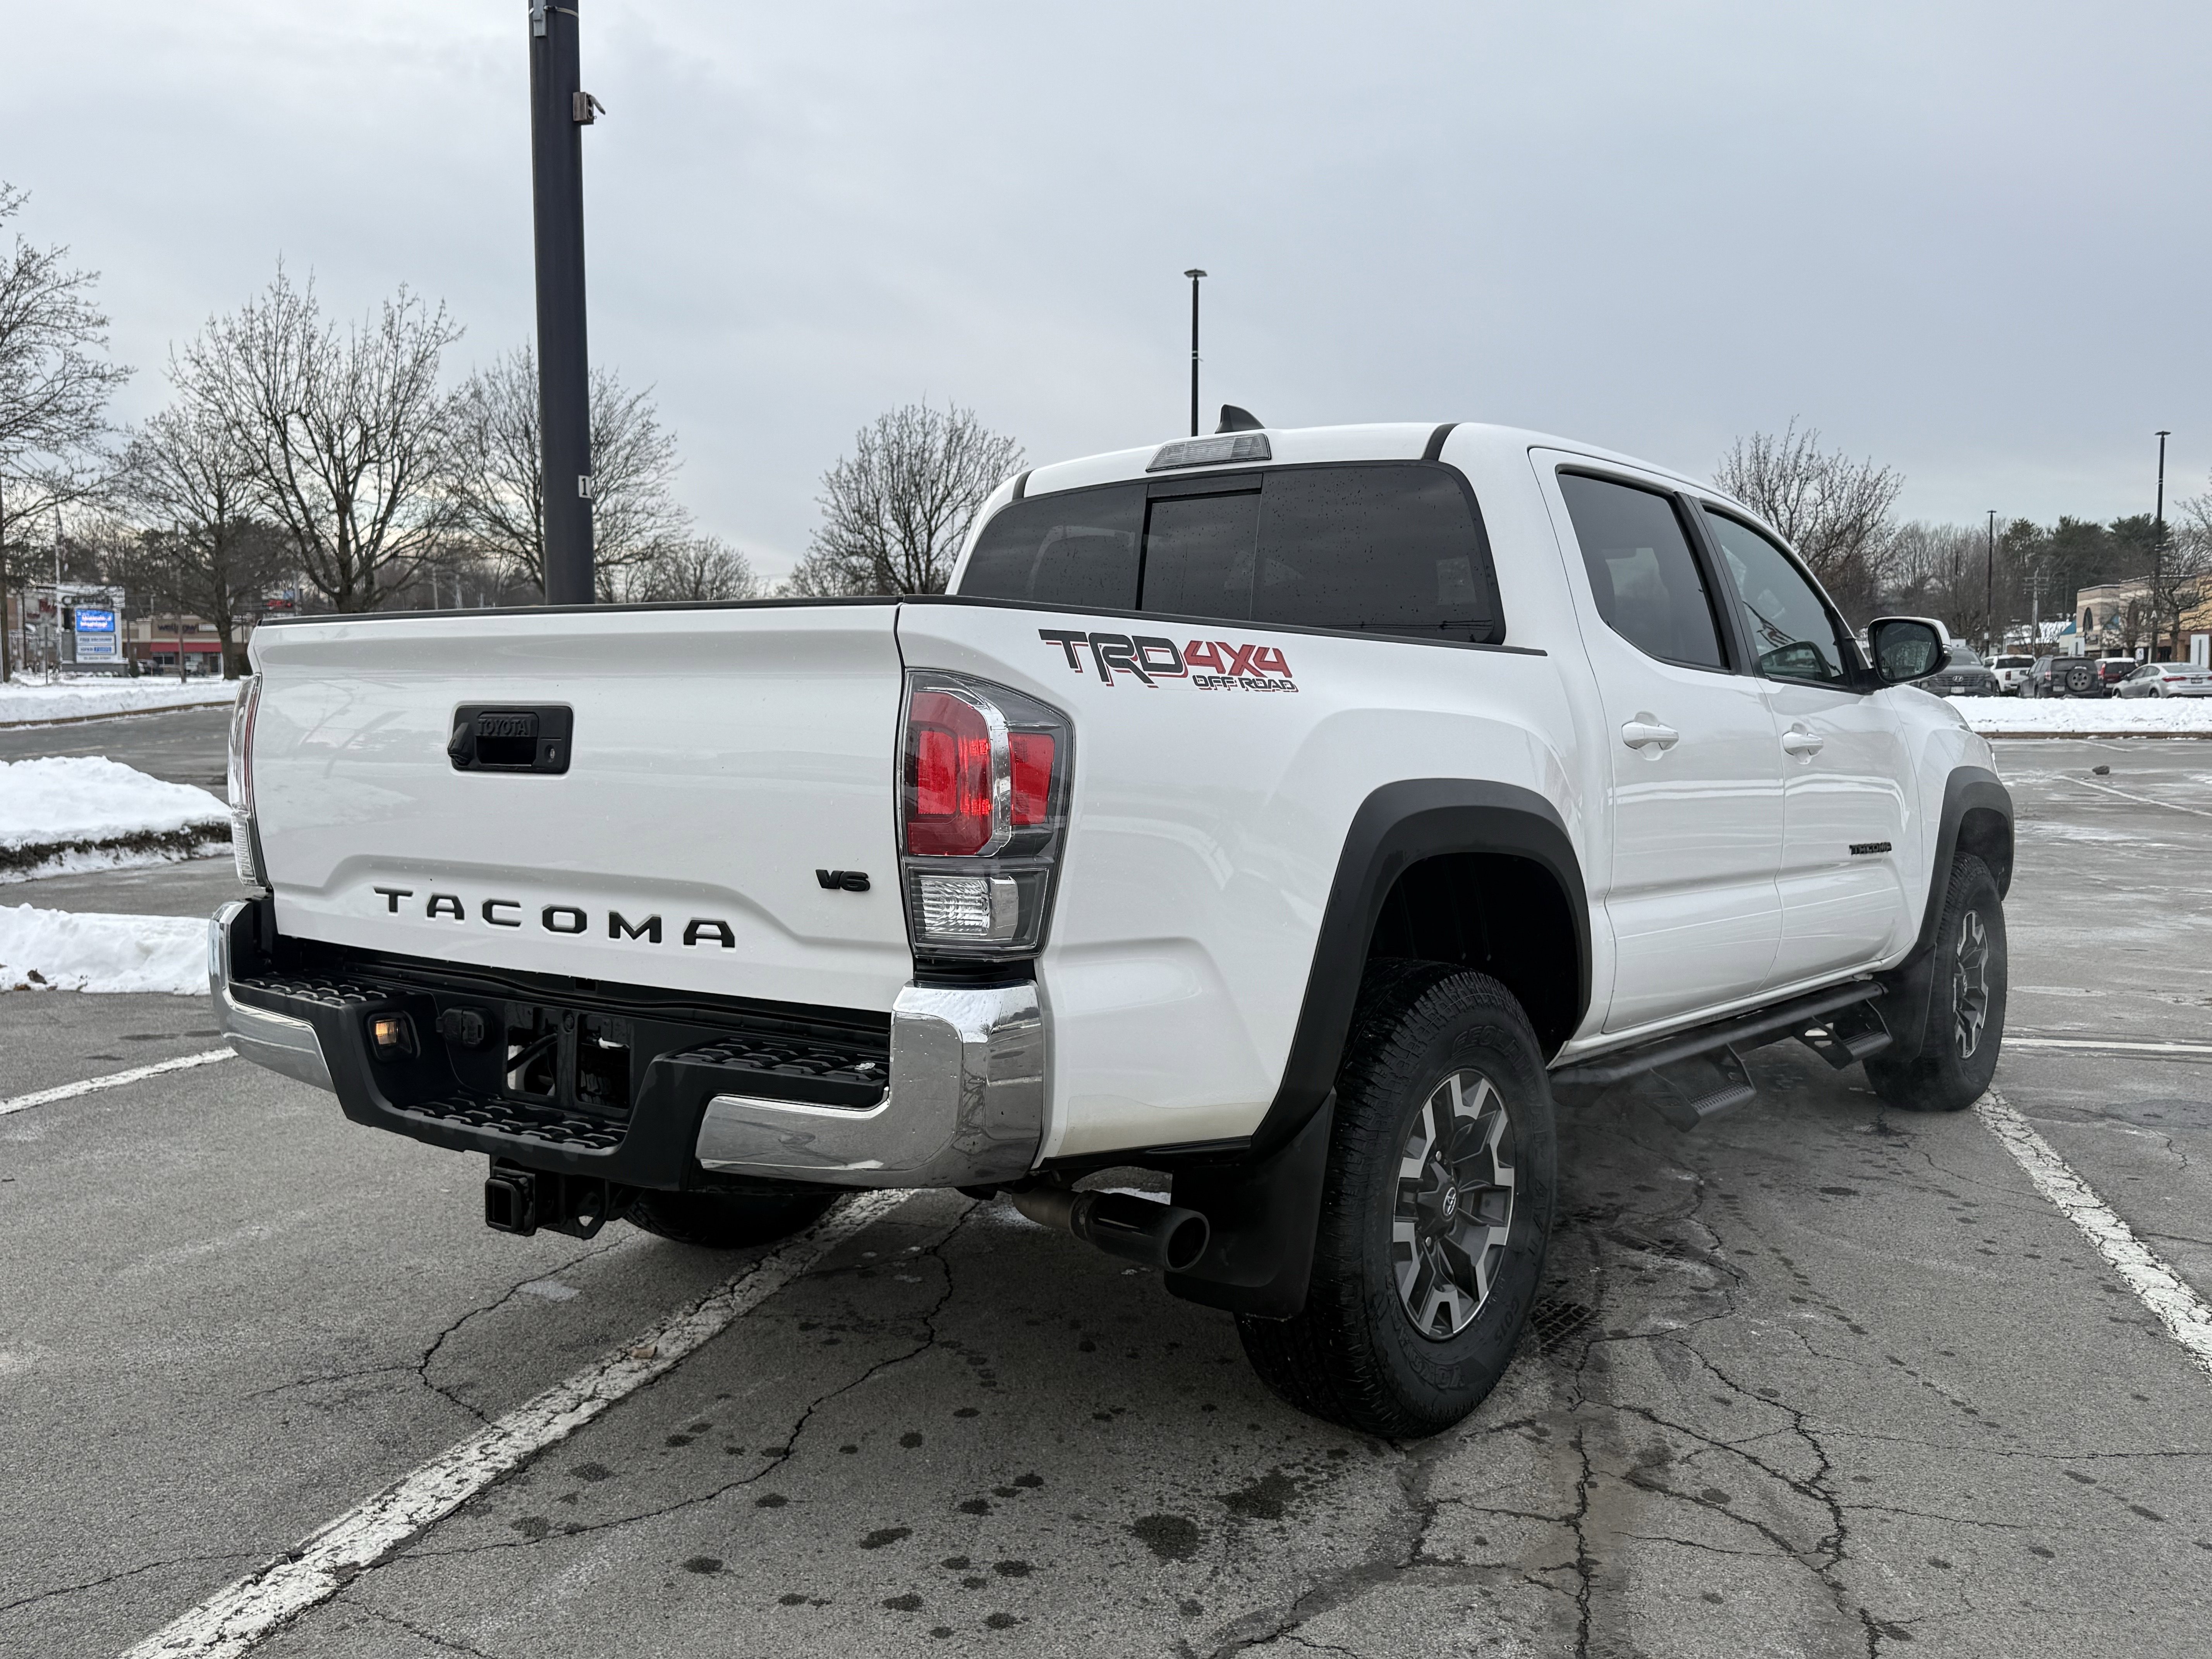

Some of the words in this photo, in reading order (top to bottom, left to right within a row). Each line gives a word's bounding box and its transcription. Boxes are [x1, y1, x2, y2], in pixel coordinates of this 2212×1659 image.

[1038, 629, 1189, 689] TRD
[1192, 675, 1238, 691] OFF
[1238, 677, 1299, 692] ROAD
[477, 719, 530, 736] TOYOTA
[815, 869, 871, 892] V6
[373, 886, 736, 948] TACOMA
